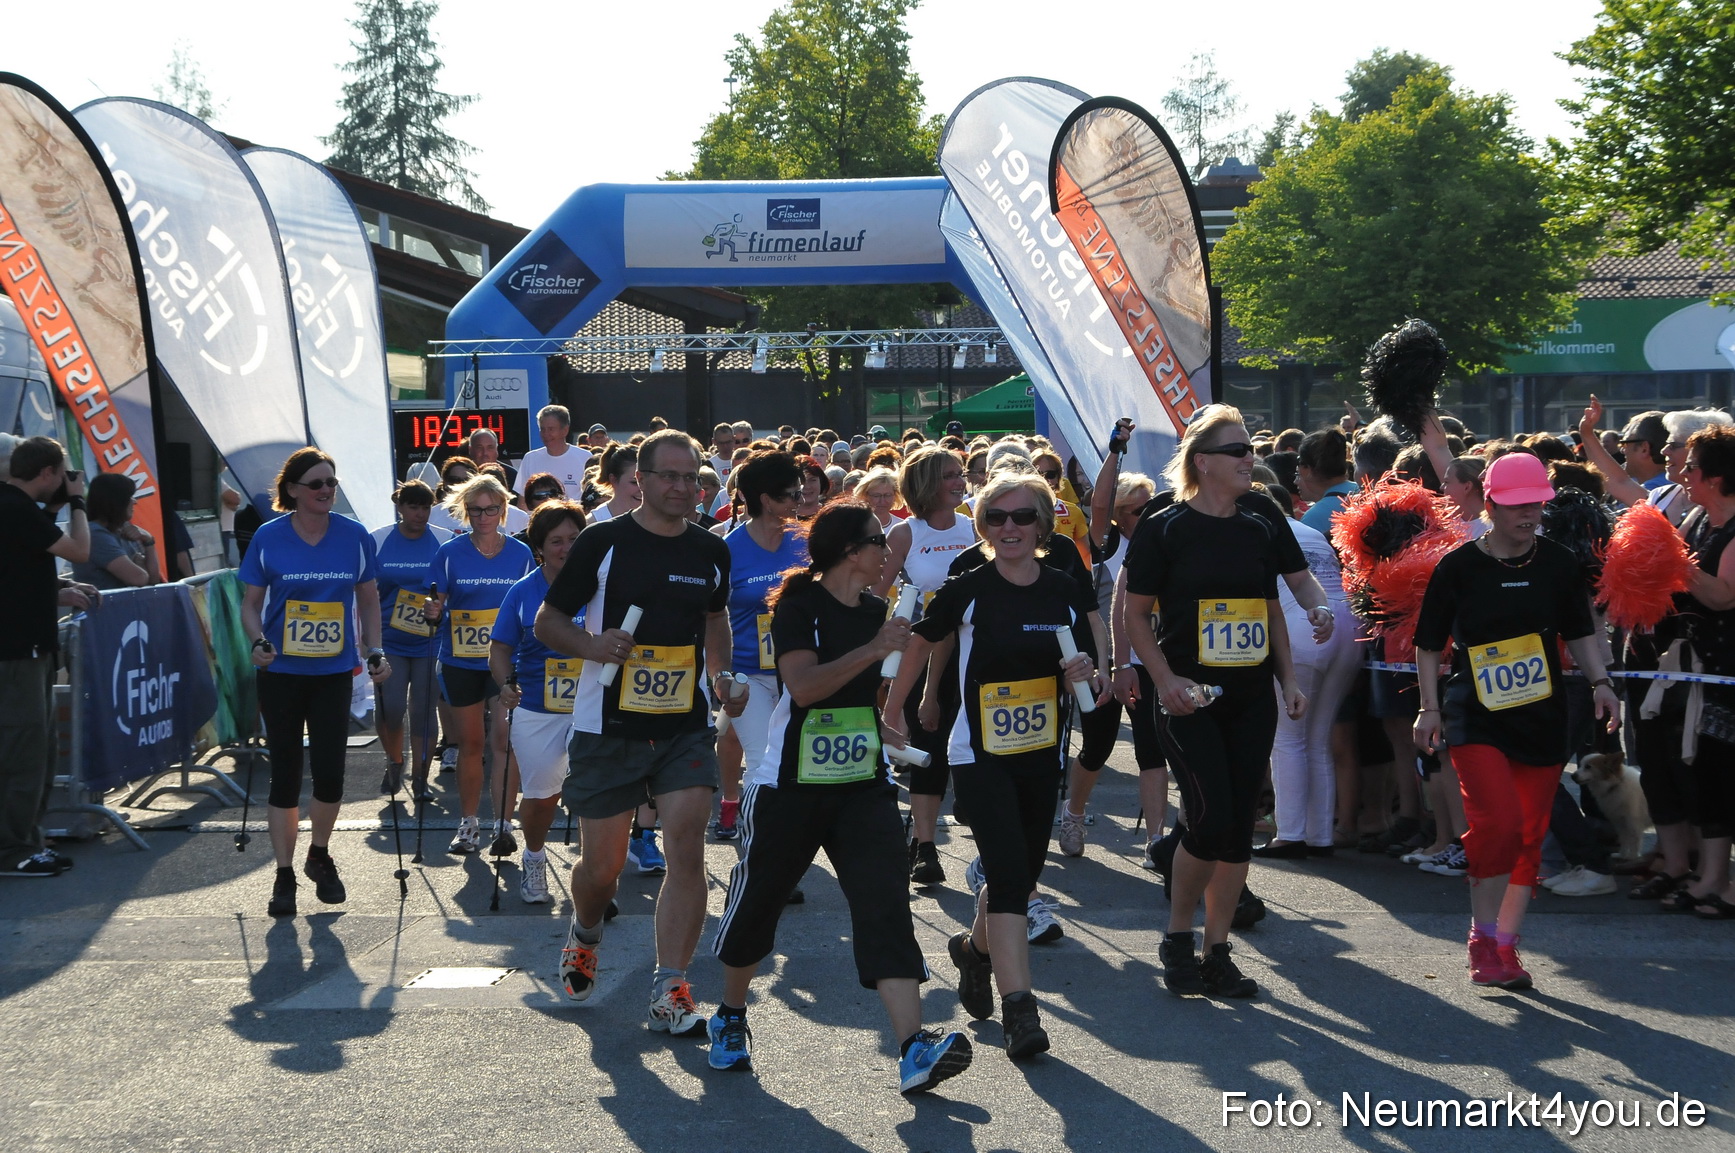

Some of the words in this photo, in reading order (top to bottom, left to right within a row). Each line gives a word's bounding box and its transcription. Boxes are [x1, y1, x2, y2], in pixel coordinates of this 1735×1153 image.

[778, 210, 818, 219] Fischer
[749, 229, 867, 252] firmenlauf
[748, 253, 798, 262] neumarkt
[521, 274, 585, 288] Fischer
[282, 571, 353, 581] energiegeladen
[675, 575, 707, 586] PFLEIDERER
[287, 619, 342, 644] 1263
[1202, 622, 1266, 650] 1130
[633, 669, 687, 698] 987
[1477, 656, 1547, 694] 1092
[547, 677, 580, 700] 12
[993, 703, 1047, 737] 985
[812, 734, 868, 765] 986
